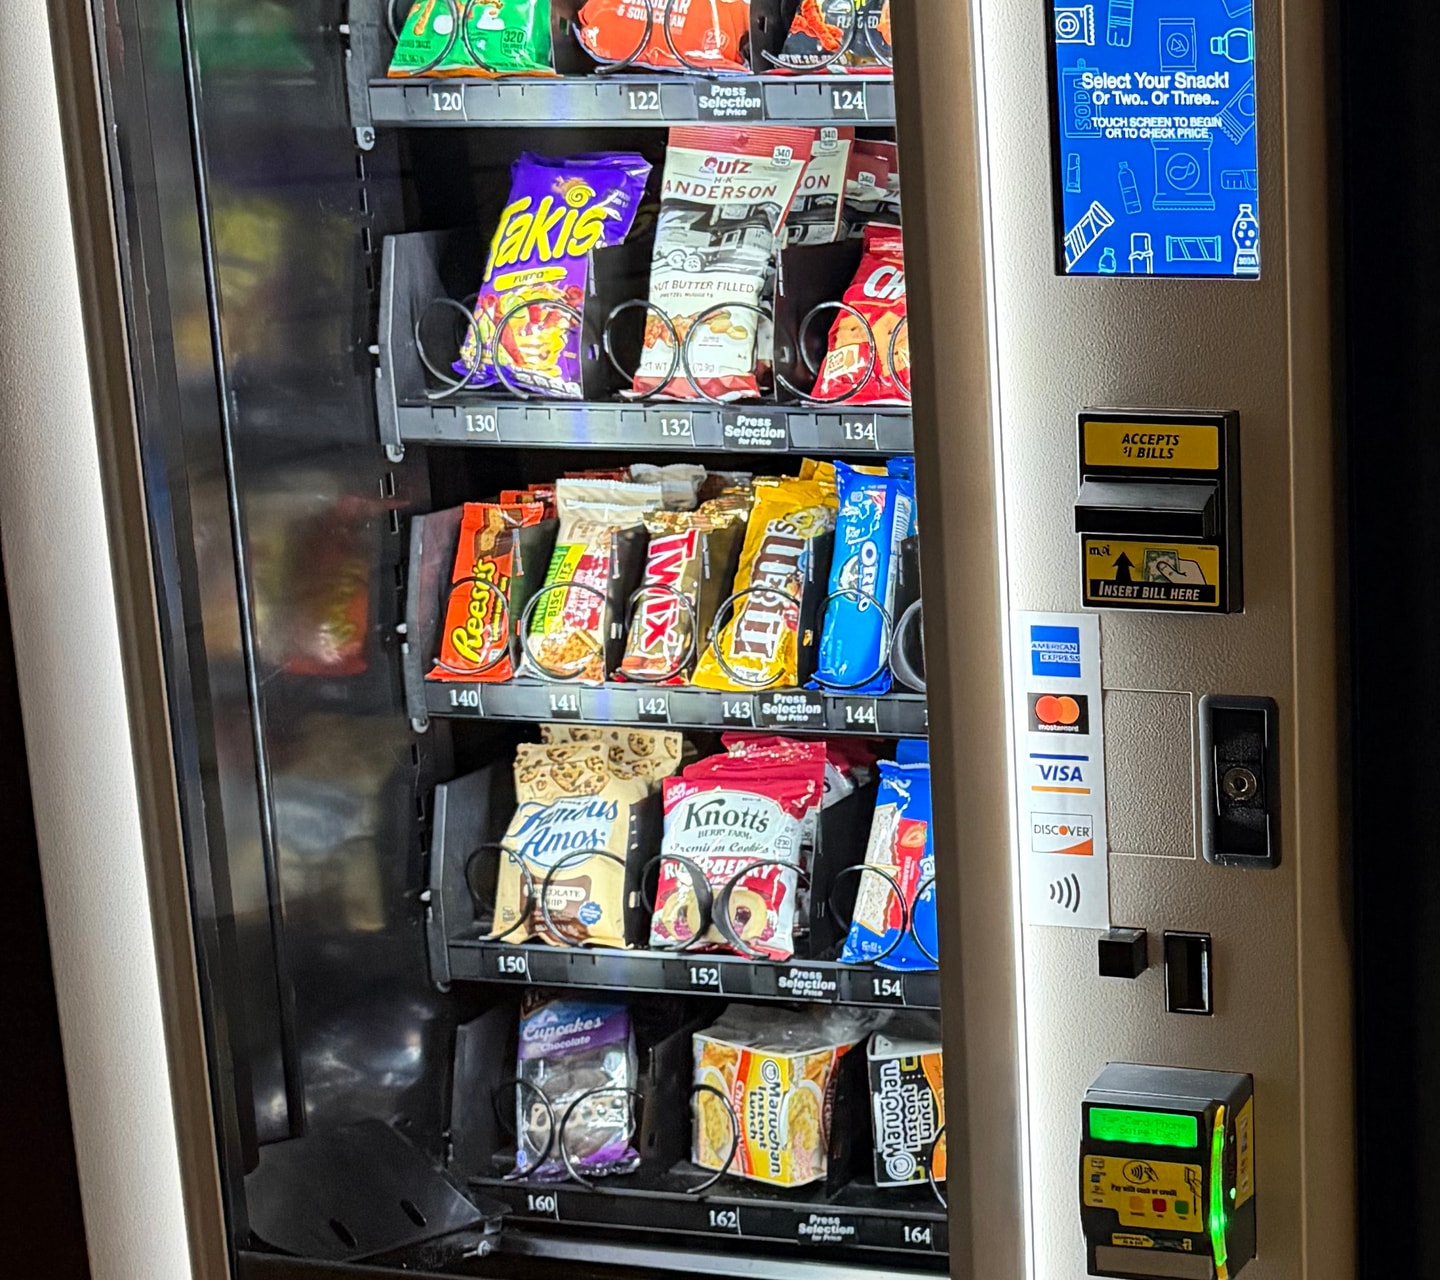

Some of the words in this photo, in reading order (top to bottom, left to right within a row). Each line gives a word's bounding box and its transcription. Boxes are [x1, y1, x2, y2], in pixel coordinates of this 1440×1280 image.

[617, 6, 624, 16] &
[503, 31, 524, 43] 320
[1082, 72, 1132, 89] Select
[1134, 72, 1171, 89] Your
[1174, 71, 1230, 89] Snack!
[711, 85, 746, 97] Press
[1092, 91, 1111, 105] Or
[1112, 91, 1148, 105] Two..
[1151, 91, 1170, 105] Or
[1171, 91, 1220, 105] Three..
[433, 92, 462, 111] 120
[629, 91, 659, 110] 122
[699, 96, 761, 109] Selection
[833, 90, 864, 110] 124
[713, 108, 725, 116] for
[726, 108, 747, 116] Price
[1092, 117, 1129, 127] TOUCH
[1130, 117, 1171, 127] SCREEN
[1173, 117, 1188, 127] TO
[1190, 117, 1222, 128] BEGIN
[1106, 128, 1122, 139] OR
[1123, 128, 1138, 139] TO
[1139, 128, 1176, 139] CHECK
[1177, 128, 1209, 139] PRICE
[775, 148, 791, 158] 340
[664, 179, 777, 199] ANDERSON
[483, 195, 608, 282] Takis
[671, 280, 714, 290] BUTTER
[716, 281, 755, 293] FILLED
[466, 415, 495, 432] 130
[661, 419, 691, 436] 132
[737, 416, 771, 427] Press
[724, 426, 785, 438] Selection
[844, 423, 874, 440] 134
[1122, 433, 1180, 446] ACCEPTS
[738, 438, 749, 446] for
[751, 438, 772, 446] Price
[1123, 446, 1132, 458] $1
[1137, 448, 1175, 459] BILLS
[548, 562, 572, 617] BISCITS
[643, 529, 700, 651] TWIX
[1099, 580, 1139, 598] INSERT
[1142, 587, 1166, 599] BILL
[1170, 588, 1200, 601] HERE
[452, 557, 496, 663] Reese's
[1031, 642, 1077, 651] AMERICAN
[1041, 653, 1080, 661] EXPRESS
[449, 690, 478, 707] 140
[550, 695, 577, 711] 141
[638, 699, 667, 715] 142
[774, 694, 807, 704] Press
[723, 702, 751, 719] 143
[762, 703, 821, 715] Selection
[845, 706, 875, 724] 144
[1038, 724, 1079, 732] mastercard
[1036, 764, 1083, 783] VISA
[507, 799, 618, 838] Famous
[683, 799, 770, 833] Knott's
[698, 829, 725, 839] BERRY
[1034, 823, 1090, 837] DISCOVER
[519, 827, 600, 857] Amos
[777, 839, 789, 847] 230
[498, 956, 526, 973] 150
[690, 967, 718, 984] 152
[790, 968, 822, 980] Press
[778, 978, 836, 990] Selection
[873, 979, 901, 996] 154
[523, 1017, 604, 1041] Cupcakes
[540, 1035, 590, 1052] Chocolate
[749, 1092, 758, 1139] Lunch
[758, 1086, 767, 1148] Instant
[883, 1060, 899, 1157] Maruchan
[905, 1085, 917, 1149] Instant
[919, 1089, 931, 1139] Lunch
[768, 1082, 781, 1174] Maruchan
[1111, 1183, 1121, 1192] Pay
[528, 1194, 554, 1211] 160
[709, 1211, 737, 1228] 162
[810, 1215, 840, 1225] Press
[798, 1224, 854, 1235] Selection
[904, 1226, 931, 1243] 164
